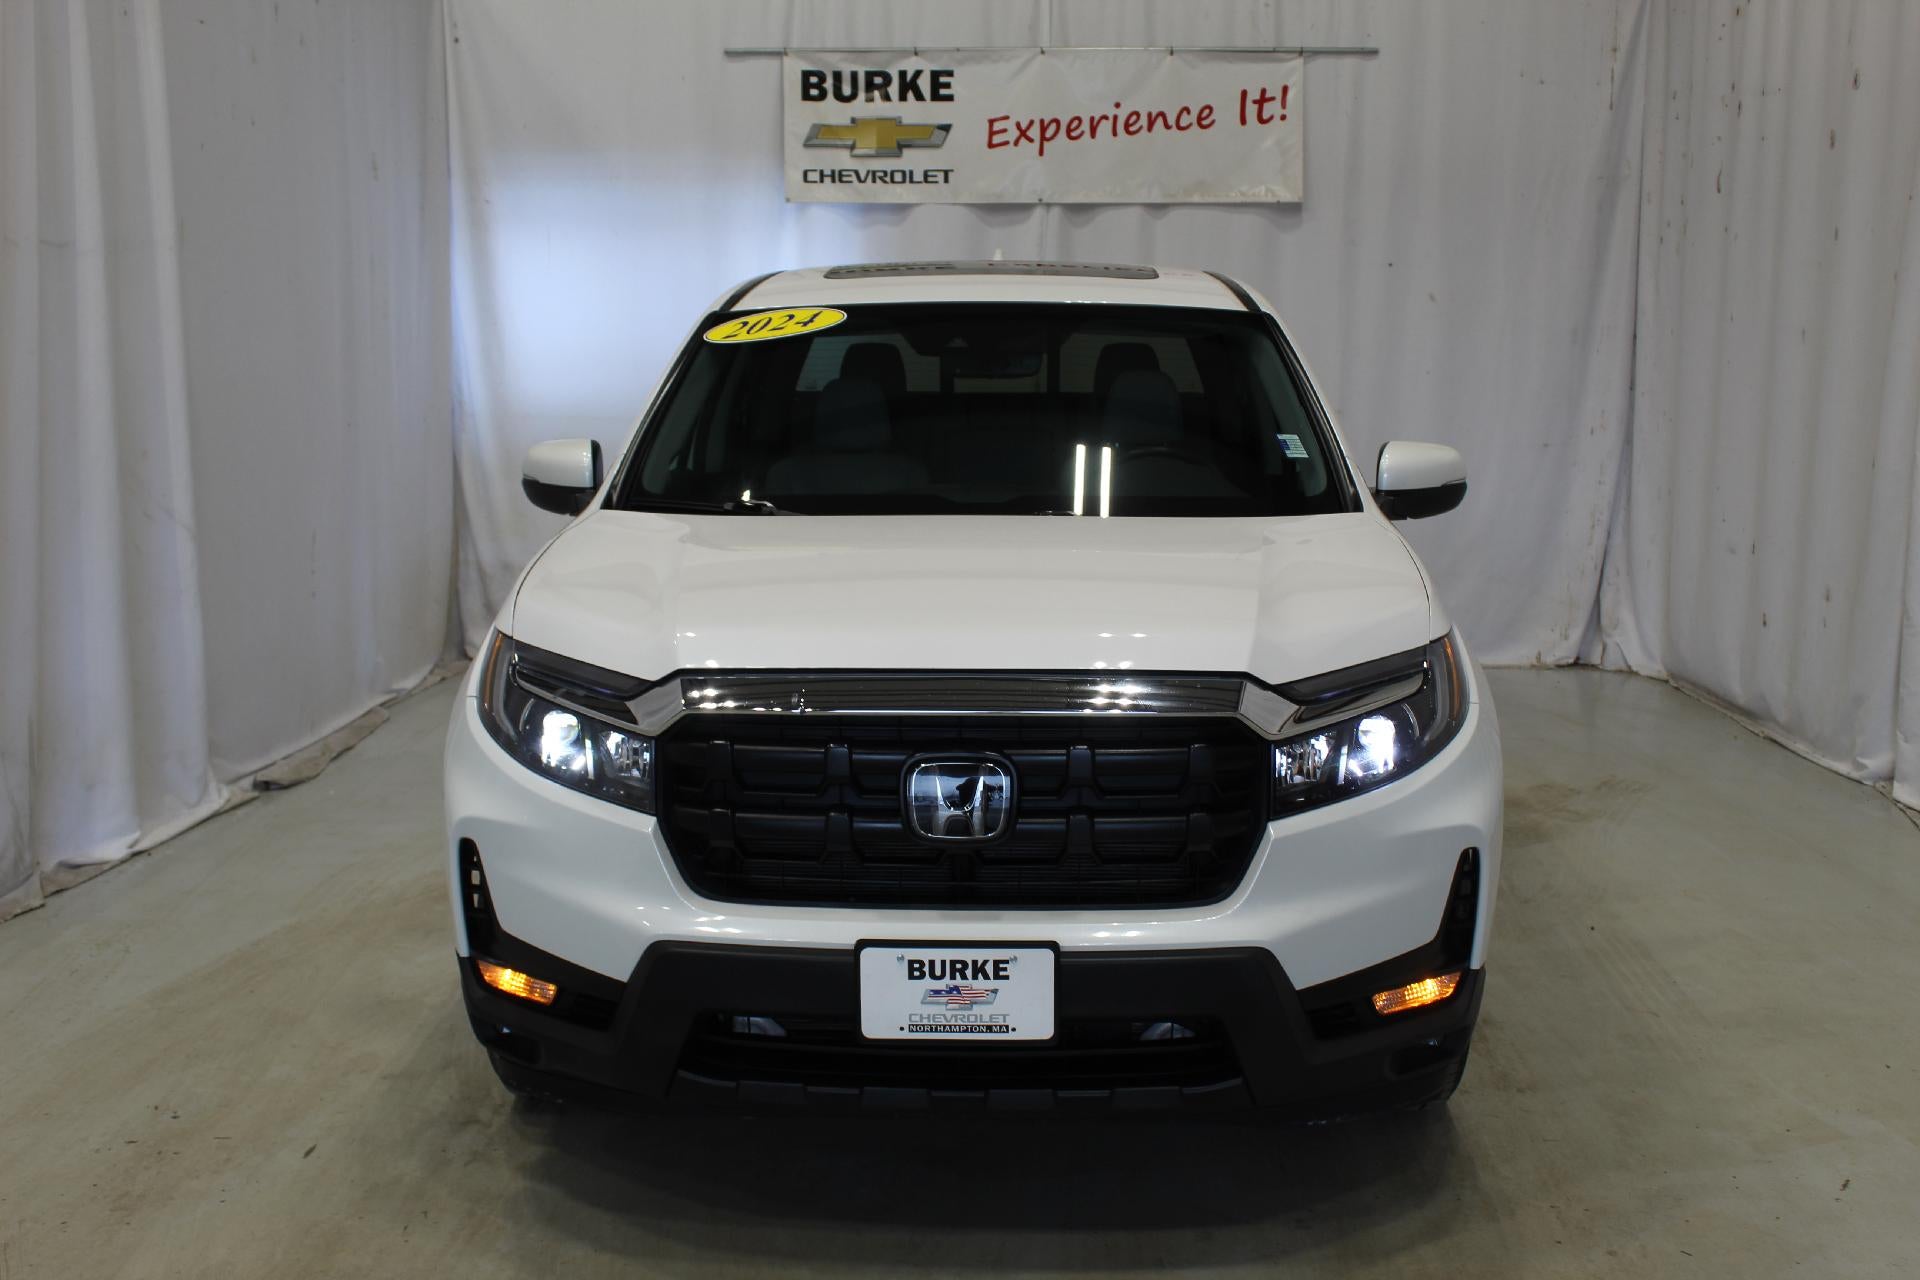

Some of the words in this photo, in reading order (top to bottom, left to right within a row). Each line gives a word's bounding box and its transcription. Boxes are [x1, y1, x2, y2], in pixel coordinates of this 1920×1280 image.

[801, 69, 954, 103] BURKE
[986, 101, 1216, 157] Experience
[1239, 84, 1289, 127] It!
[802, 169, 954, 184] CHEVROLET
[722, 310, 823, 339] 2024
[907, 959, 1010, 981] BURKE
[908, 1013, 1010, 1024] CHEVROLET
[992, 1025, 1007, 1033] MA
